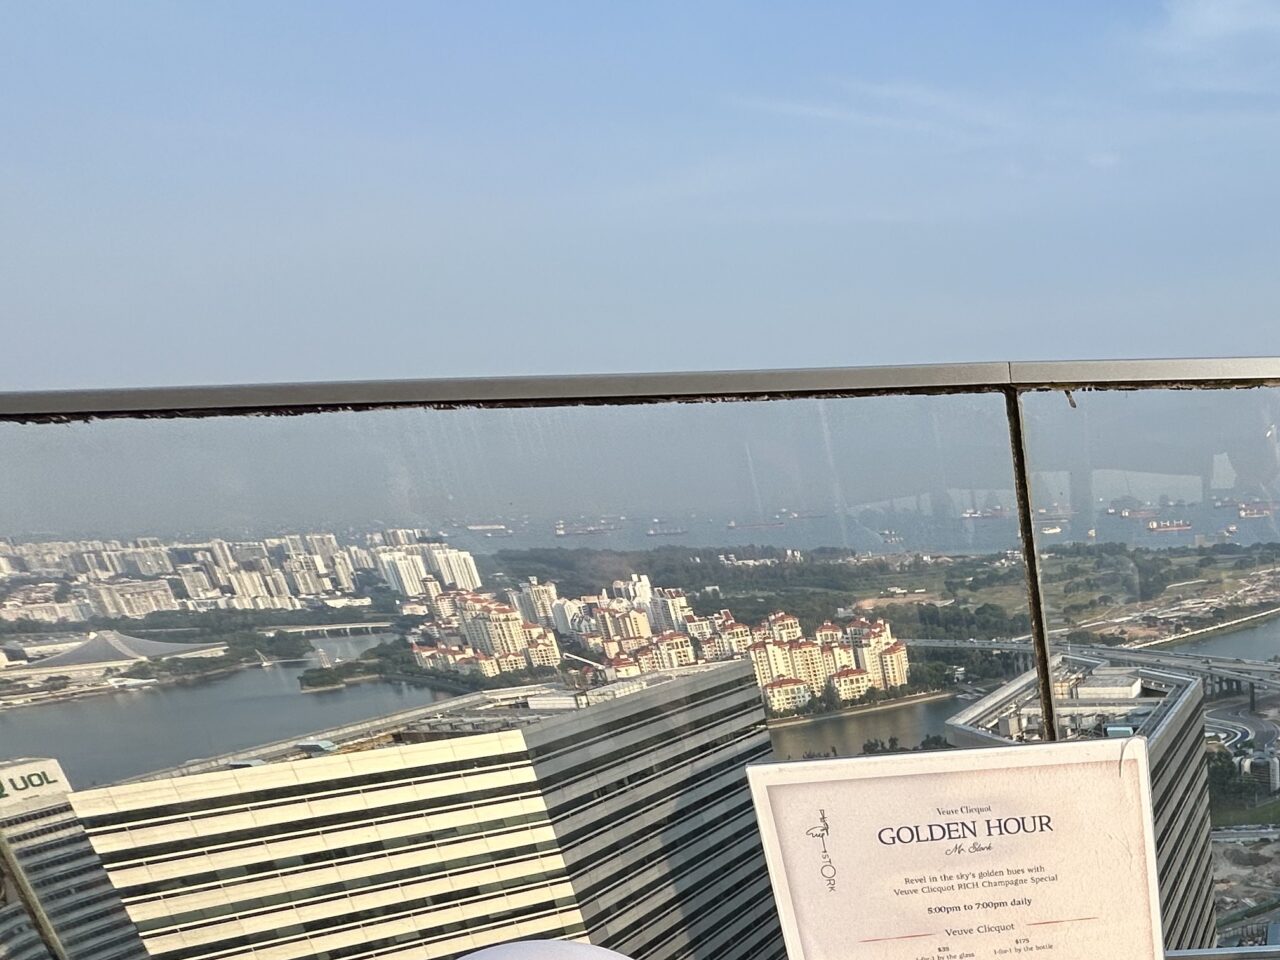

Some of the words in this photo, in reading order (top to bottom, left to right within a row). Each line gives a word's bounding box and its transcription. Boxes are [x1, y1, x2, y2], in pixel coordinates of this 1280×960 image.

[8, 771, 58, 791] UOL
[936, 806, 958, 816] Veuve
[960, 804, 992, 815] Clicquot
[877, 820, 977, 845] GOLDEN
[985, 815, 1053, 837] HOUR
[893, 887, 918, 896] Veuve
[921, 884, 955, 895] Clicquot
[957, 881, 979, 891] RICH
[981, 877, 1028, 889] Champagne
[1030, 874, 1058, 885] Special
[904, 876, 926, 885] Revel
[929, 875, 937, 883] in
[939, 873, 953, 882] the
[956, 871, 976, 881] sky's
[978, 869, 1004, 879] golden
[1027, 865, 1045, 874] with
[927, 905, 961, 915] 5:00pm
[964, 903, 973, 912] to
[974, 900, 1008, 911] 7:00pm
[1010, 897, 1032, 907] daily
[945, 928, 974, 937] Veuve
[977, 923, 1015, 935] Clicquot
